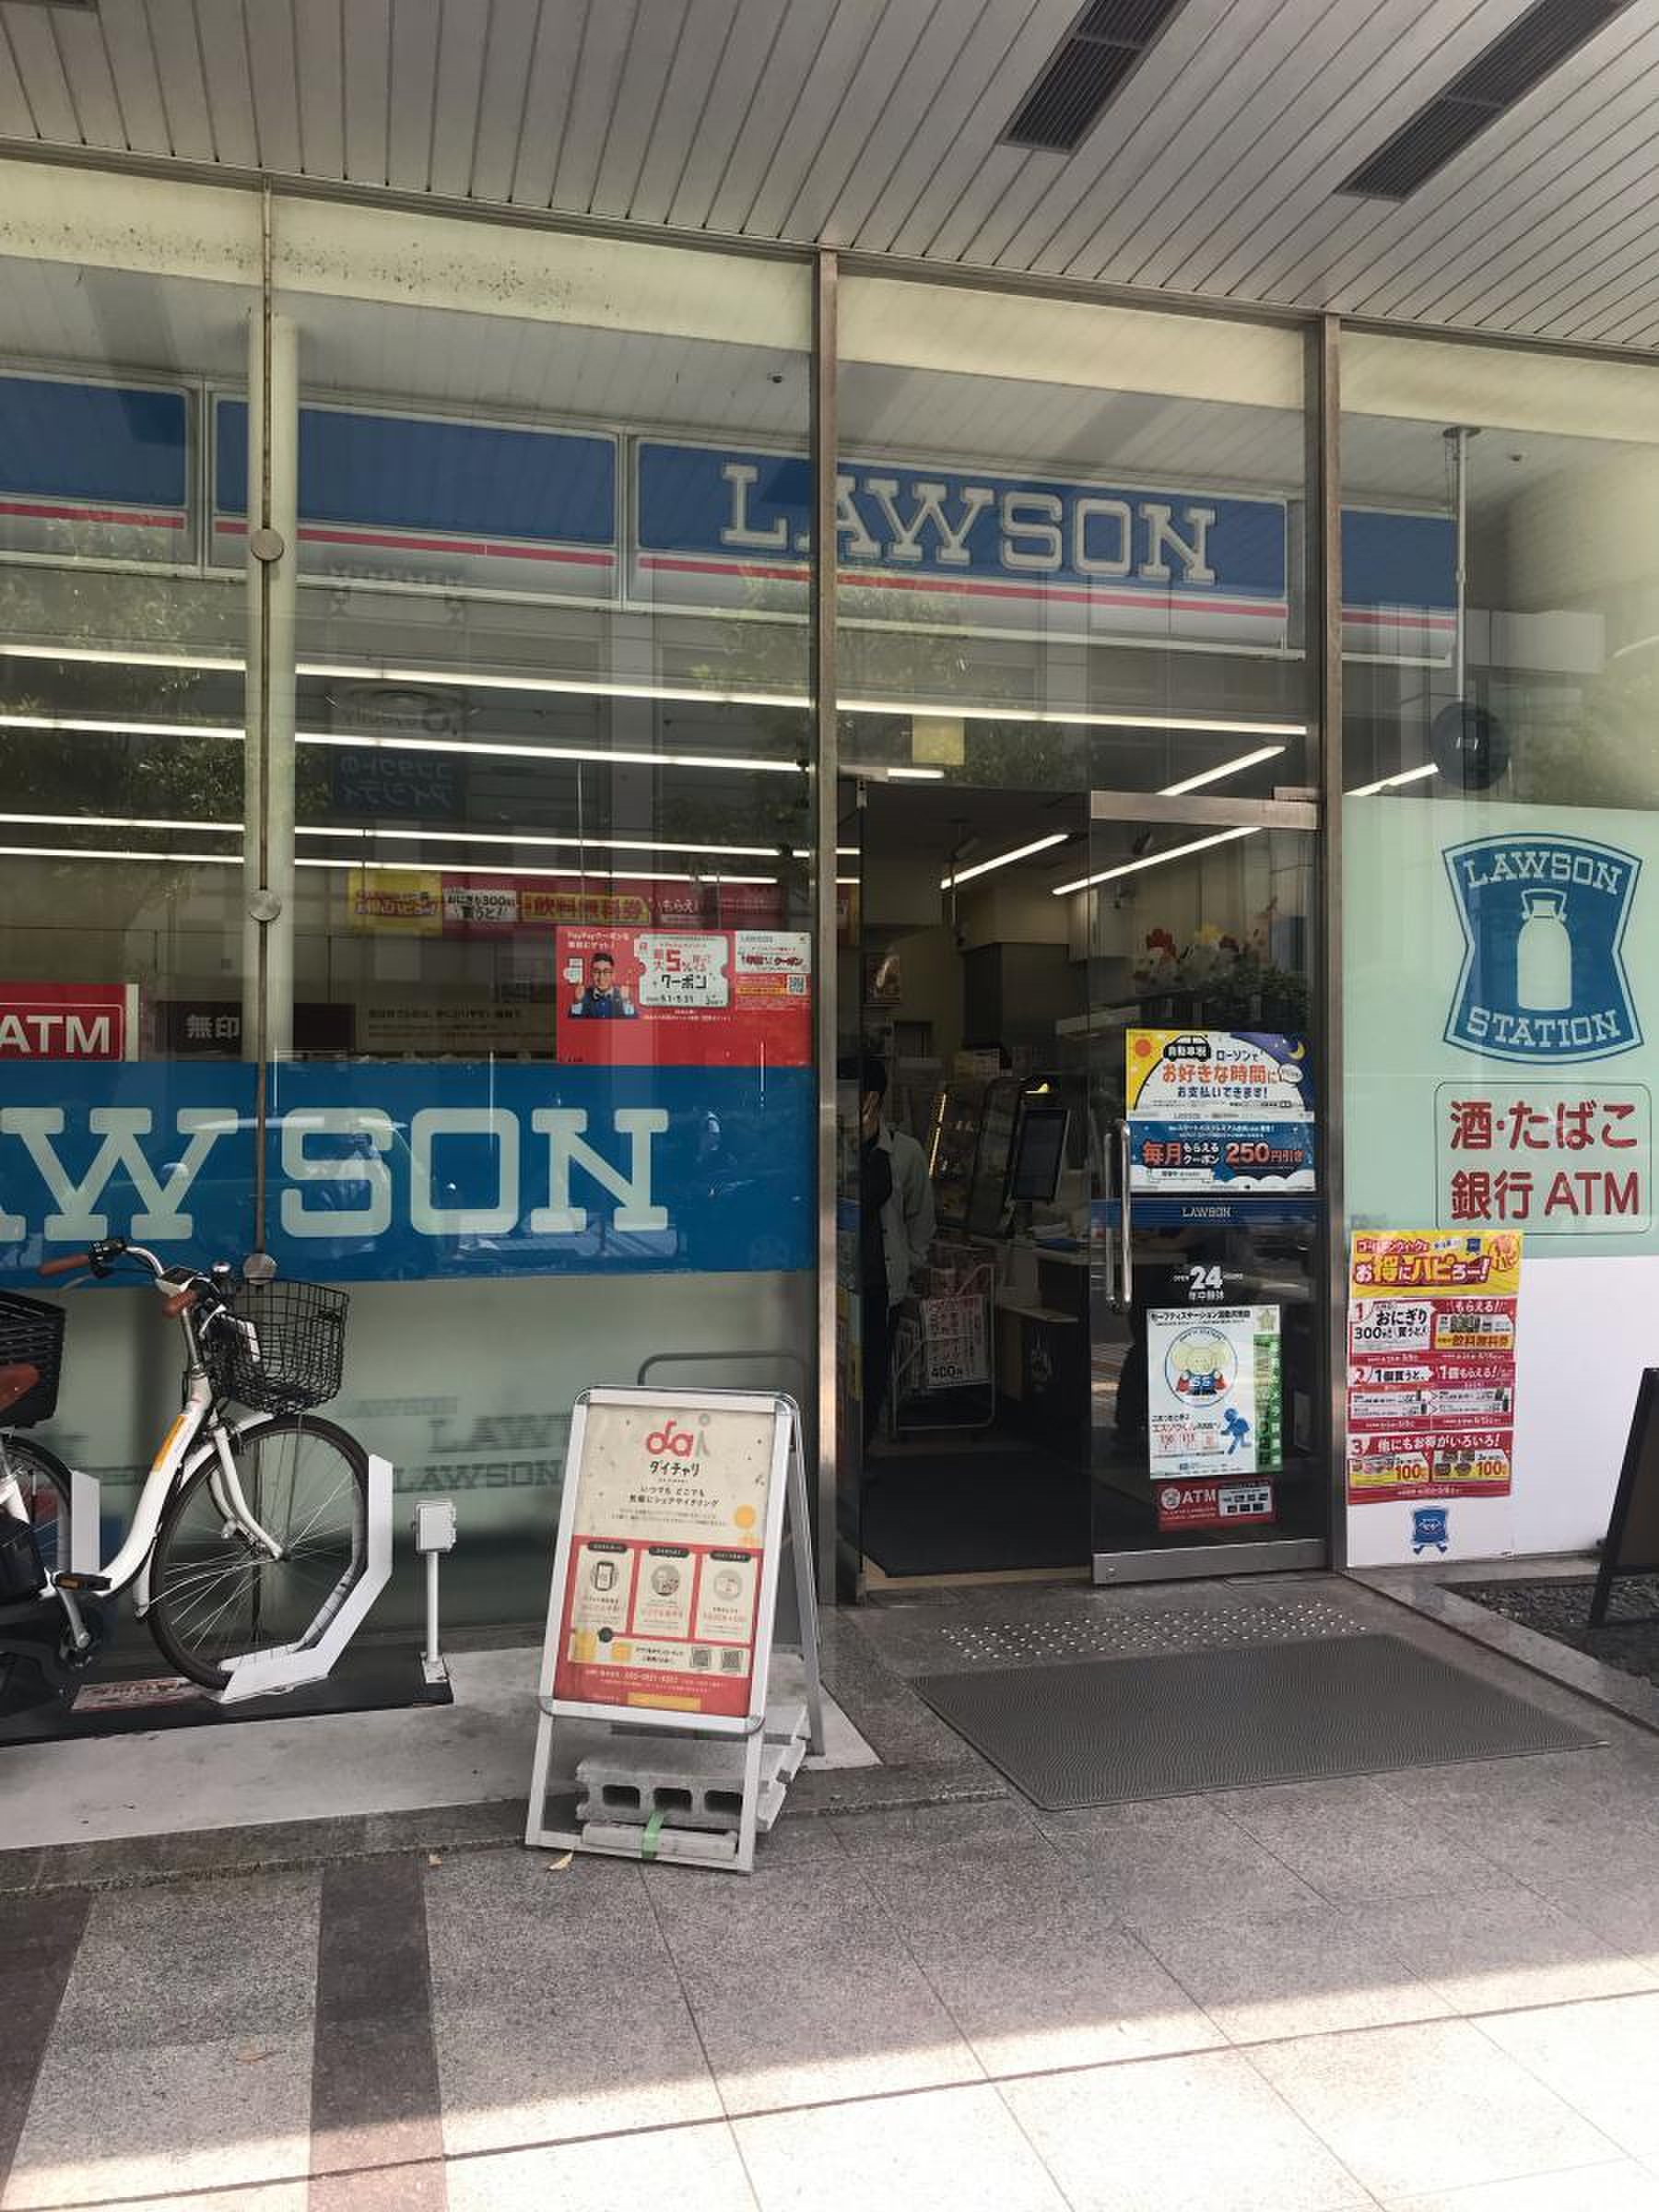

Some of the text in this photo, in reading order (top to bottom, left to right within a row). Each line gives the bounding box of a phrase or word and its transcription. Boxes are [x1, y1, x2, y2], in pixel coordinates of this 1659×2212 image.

[722, 465, 1217, 586] LAWSON
[1464, 850, 1623, 895] LAWSON
[661, 974, 708, 989] クーポン
[0, 1015, 110, 1054] ATM
[187, 1014, 241, 1040] 無印
[1466, 1006, 1621, 1048] STATION
[1216, 1050, 1259, 1061] ローソンで
[1163, 1063, 1278, 1084] お好きな時間に
[1177, 1087, 1268, 1100] お支払いできます!
[1143, 1141, 1182, 1165] 毎月
[1182, 1143, 1220, 1153] もらえる
[1182, 1155, 1220, 1165] クーポン
[0, 1107, 669, 1241] WSON
[1452, 1170, 1640, 1221] 銀行 ATM
[1182, 1206, 1231, 1218] LAWSON
[1190, 1265, 1223, 1289] 24
[1356, 1252, 1490, 1282] お得にハピろー!
[1376, 1308, 1428, 1326] おにぎり
[649, 1460, 700, 1477] ダイチャリ
[1182, 1489, 1217, 1505] ATM
